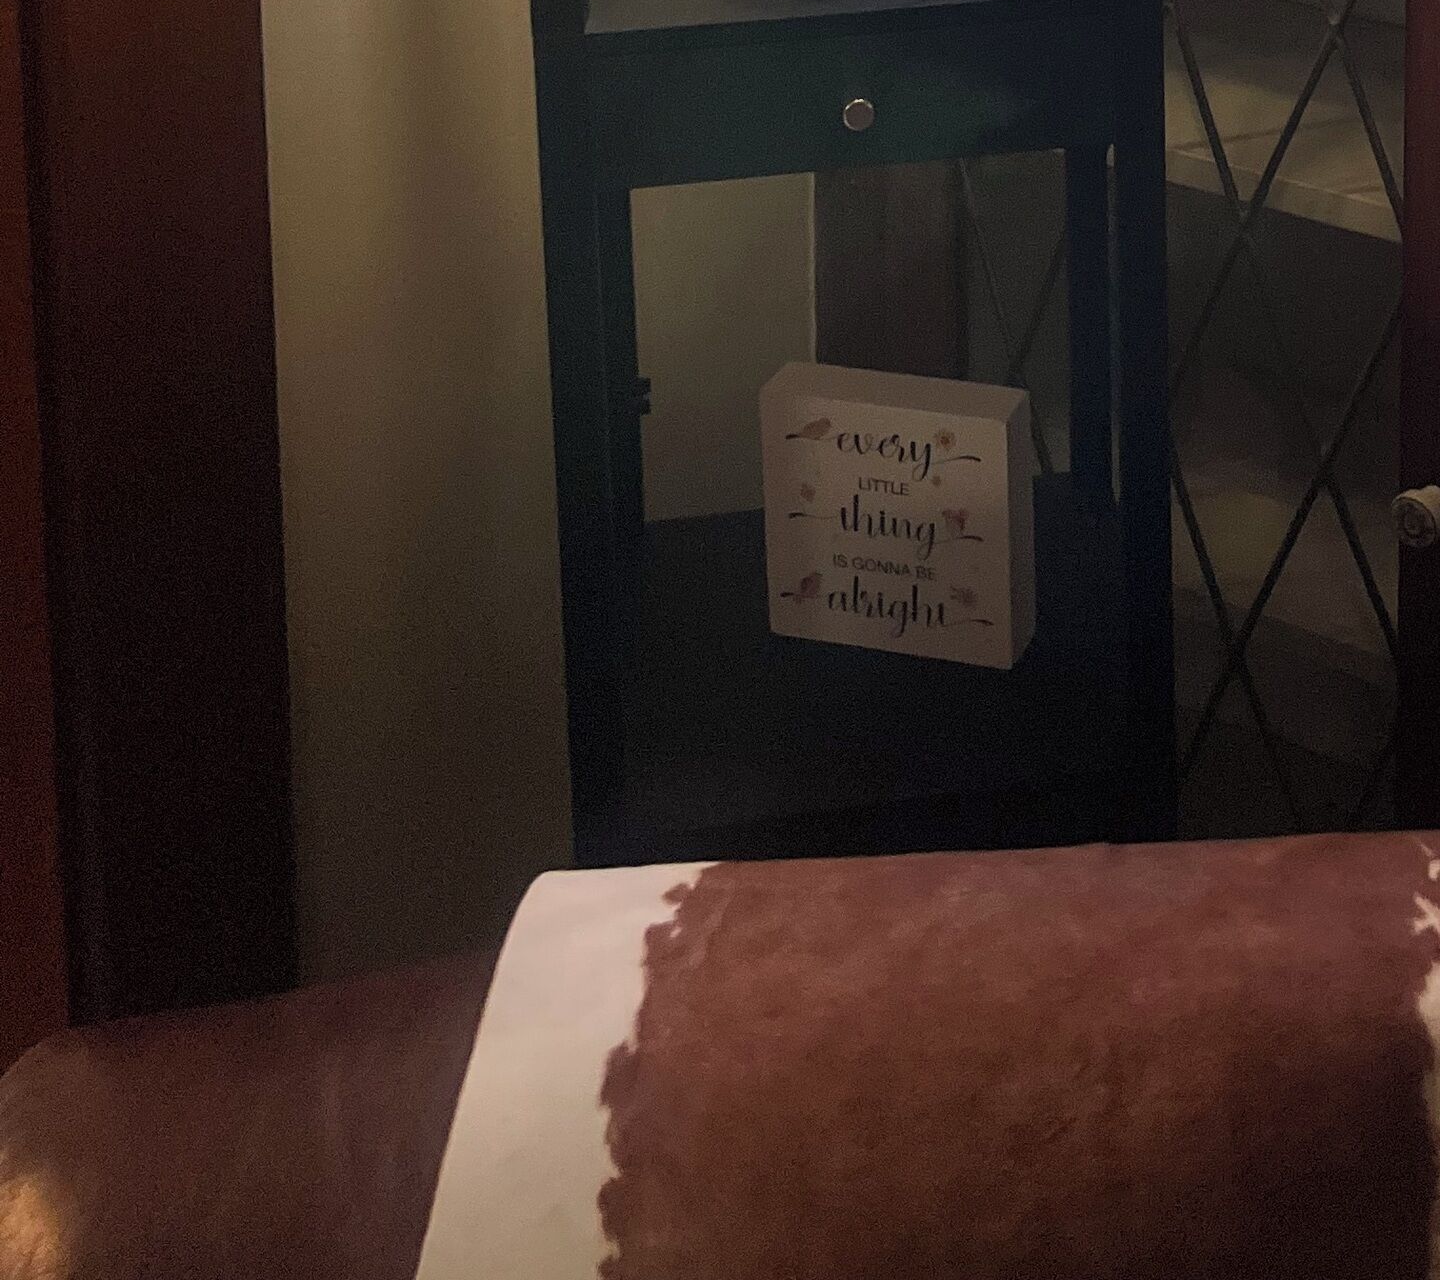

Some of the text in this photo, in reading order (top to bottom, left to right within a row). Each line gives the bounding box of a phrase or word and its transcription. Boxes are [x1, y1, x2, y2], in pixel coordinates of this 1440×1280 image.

[836, 432, 934, 482] every
[858, 476, 911, 496] LITTLE
[839, 494, 936, 561] thing
[832, 552, 938, 581] IS GONNA BE
[827, 575, 947, 639] alright
